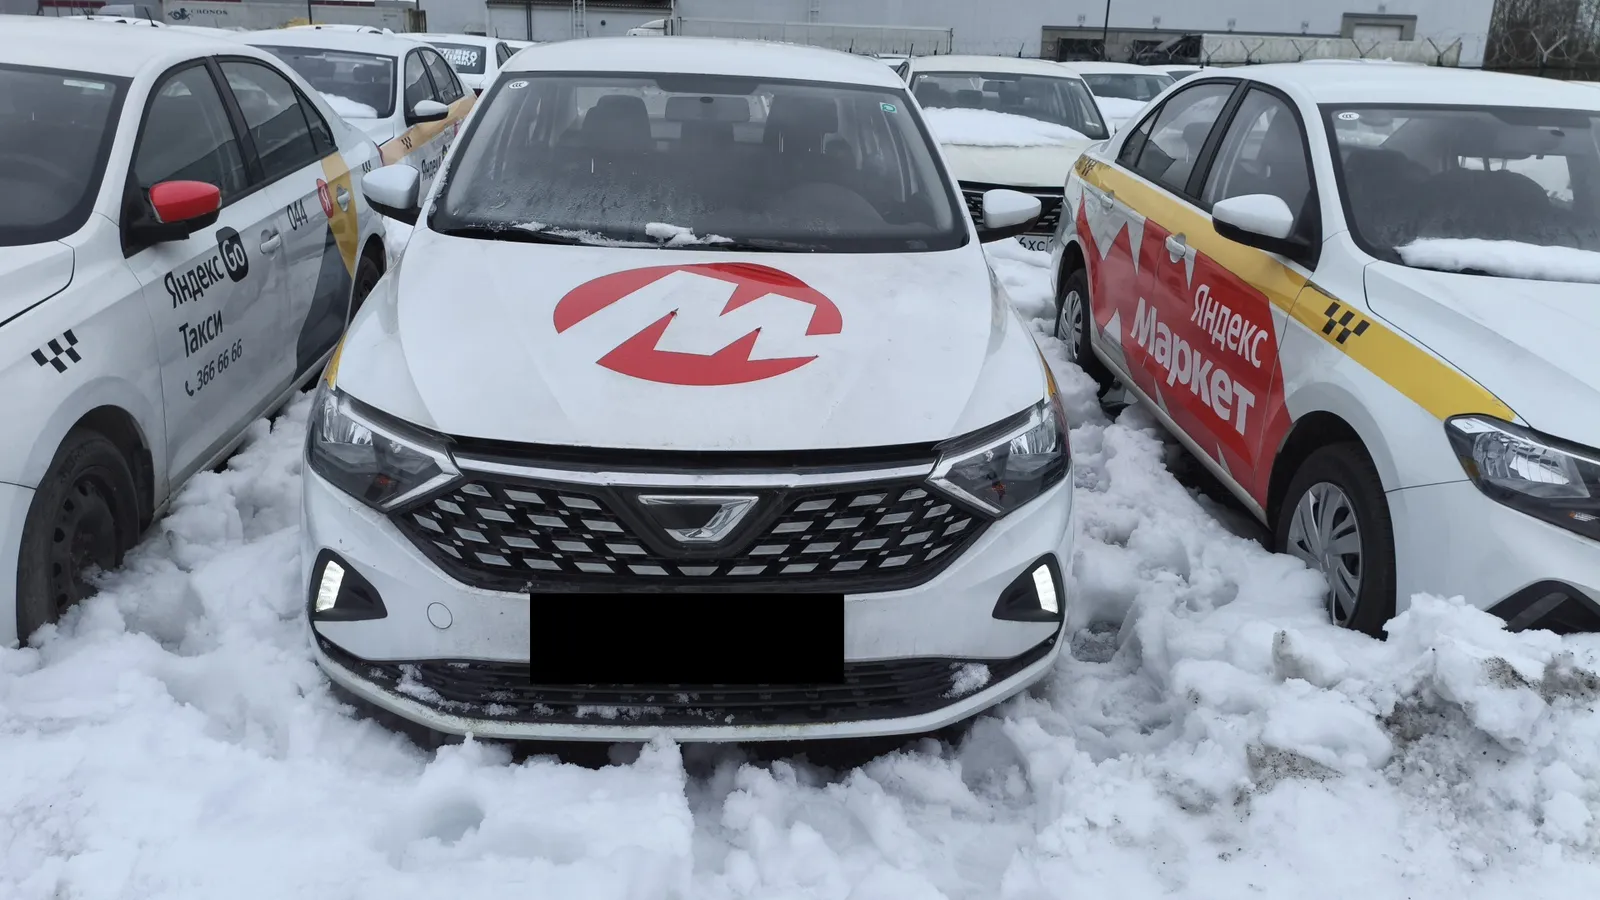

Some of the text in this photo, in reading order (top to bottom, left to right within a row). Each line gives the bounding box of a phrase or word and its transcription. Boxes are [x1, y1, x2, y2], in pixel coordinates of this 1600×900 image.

[286, 199, 309, 231] 044
[164, 239, 244, 309] Яндекс Go
[179, 309, 223, 358] Такси
[1190, 283, 1268, 369] Яндекс
[196, 338, 243, 391] 366 66 66
[1130, 296, 1255, 436] Маркет
